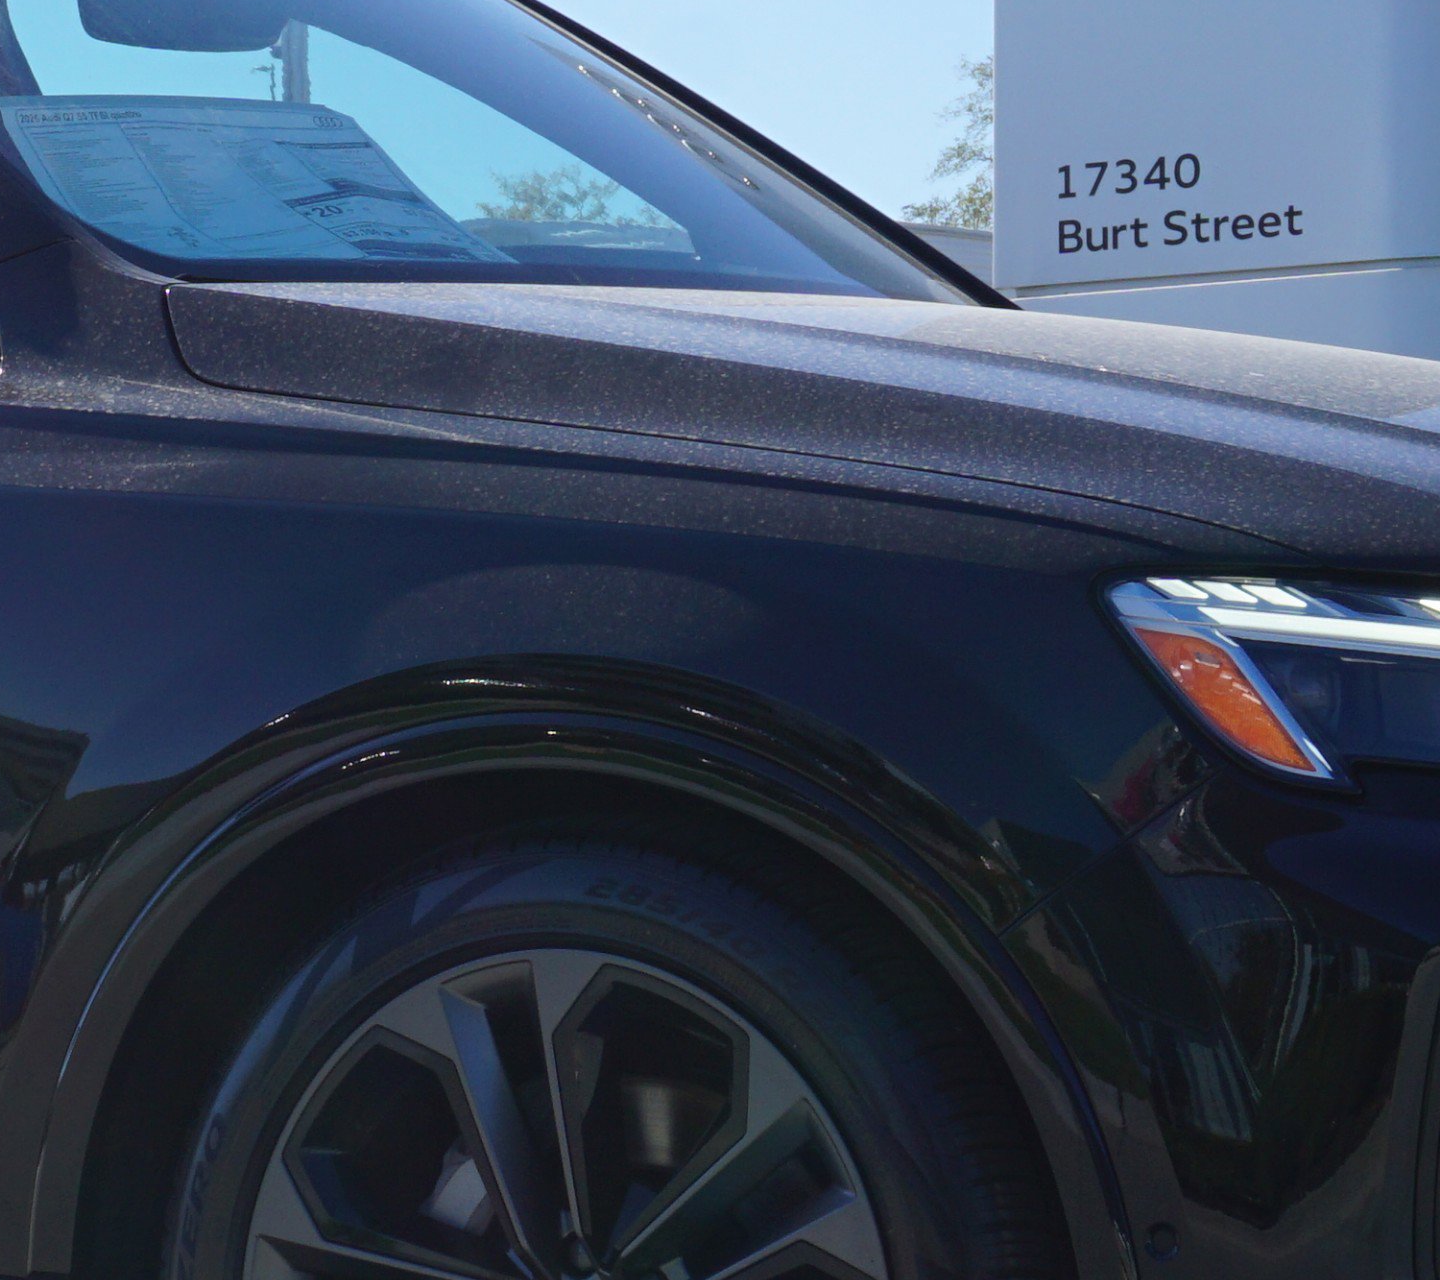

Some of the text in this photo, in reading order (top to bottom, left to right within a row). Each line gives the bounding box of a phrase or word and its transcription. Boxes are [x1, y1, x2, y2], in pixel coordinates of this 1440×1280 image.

[1057, 153, 1201, 199] 17340
[1057, 204, 1304, 255] Burt Street
